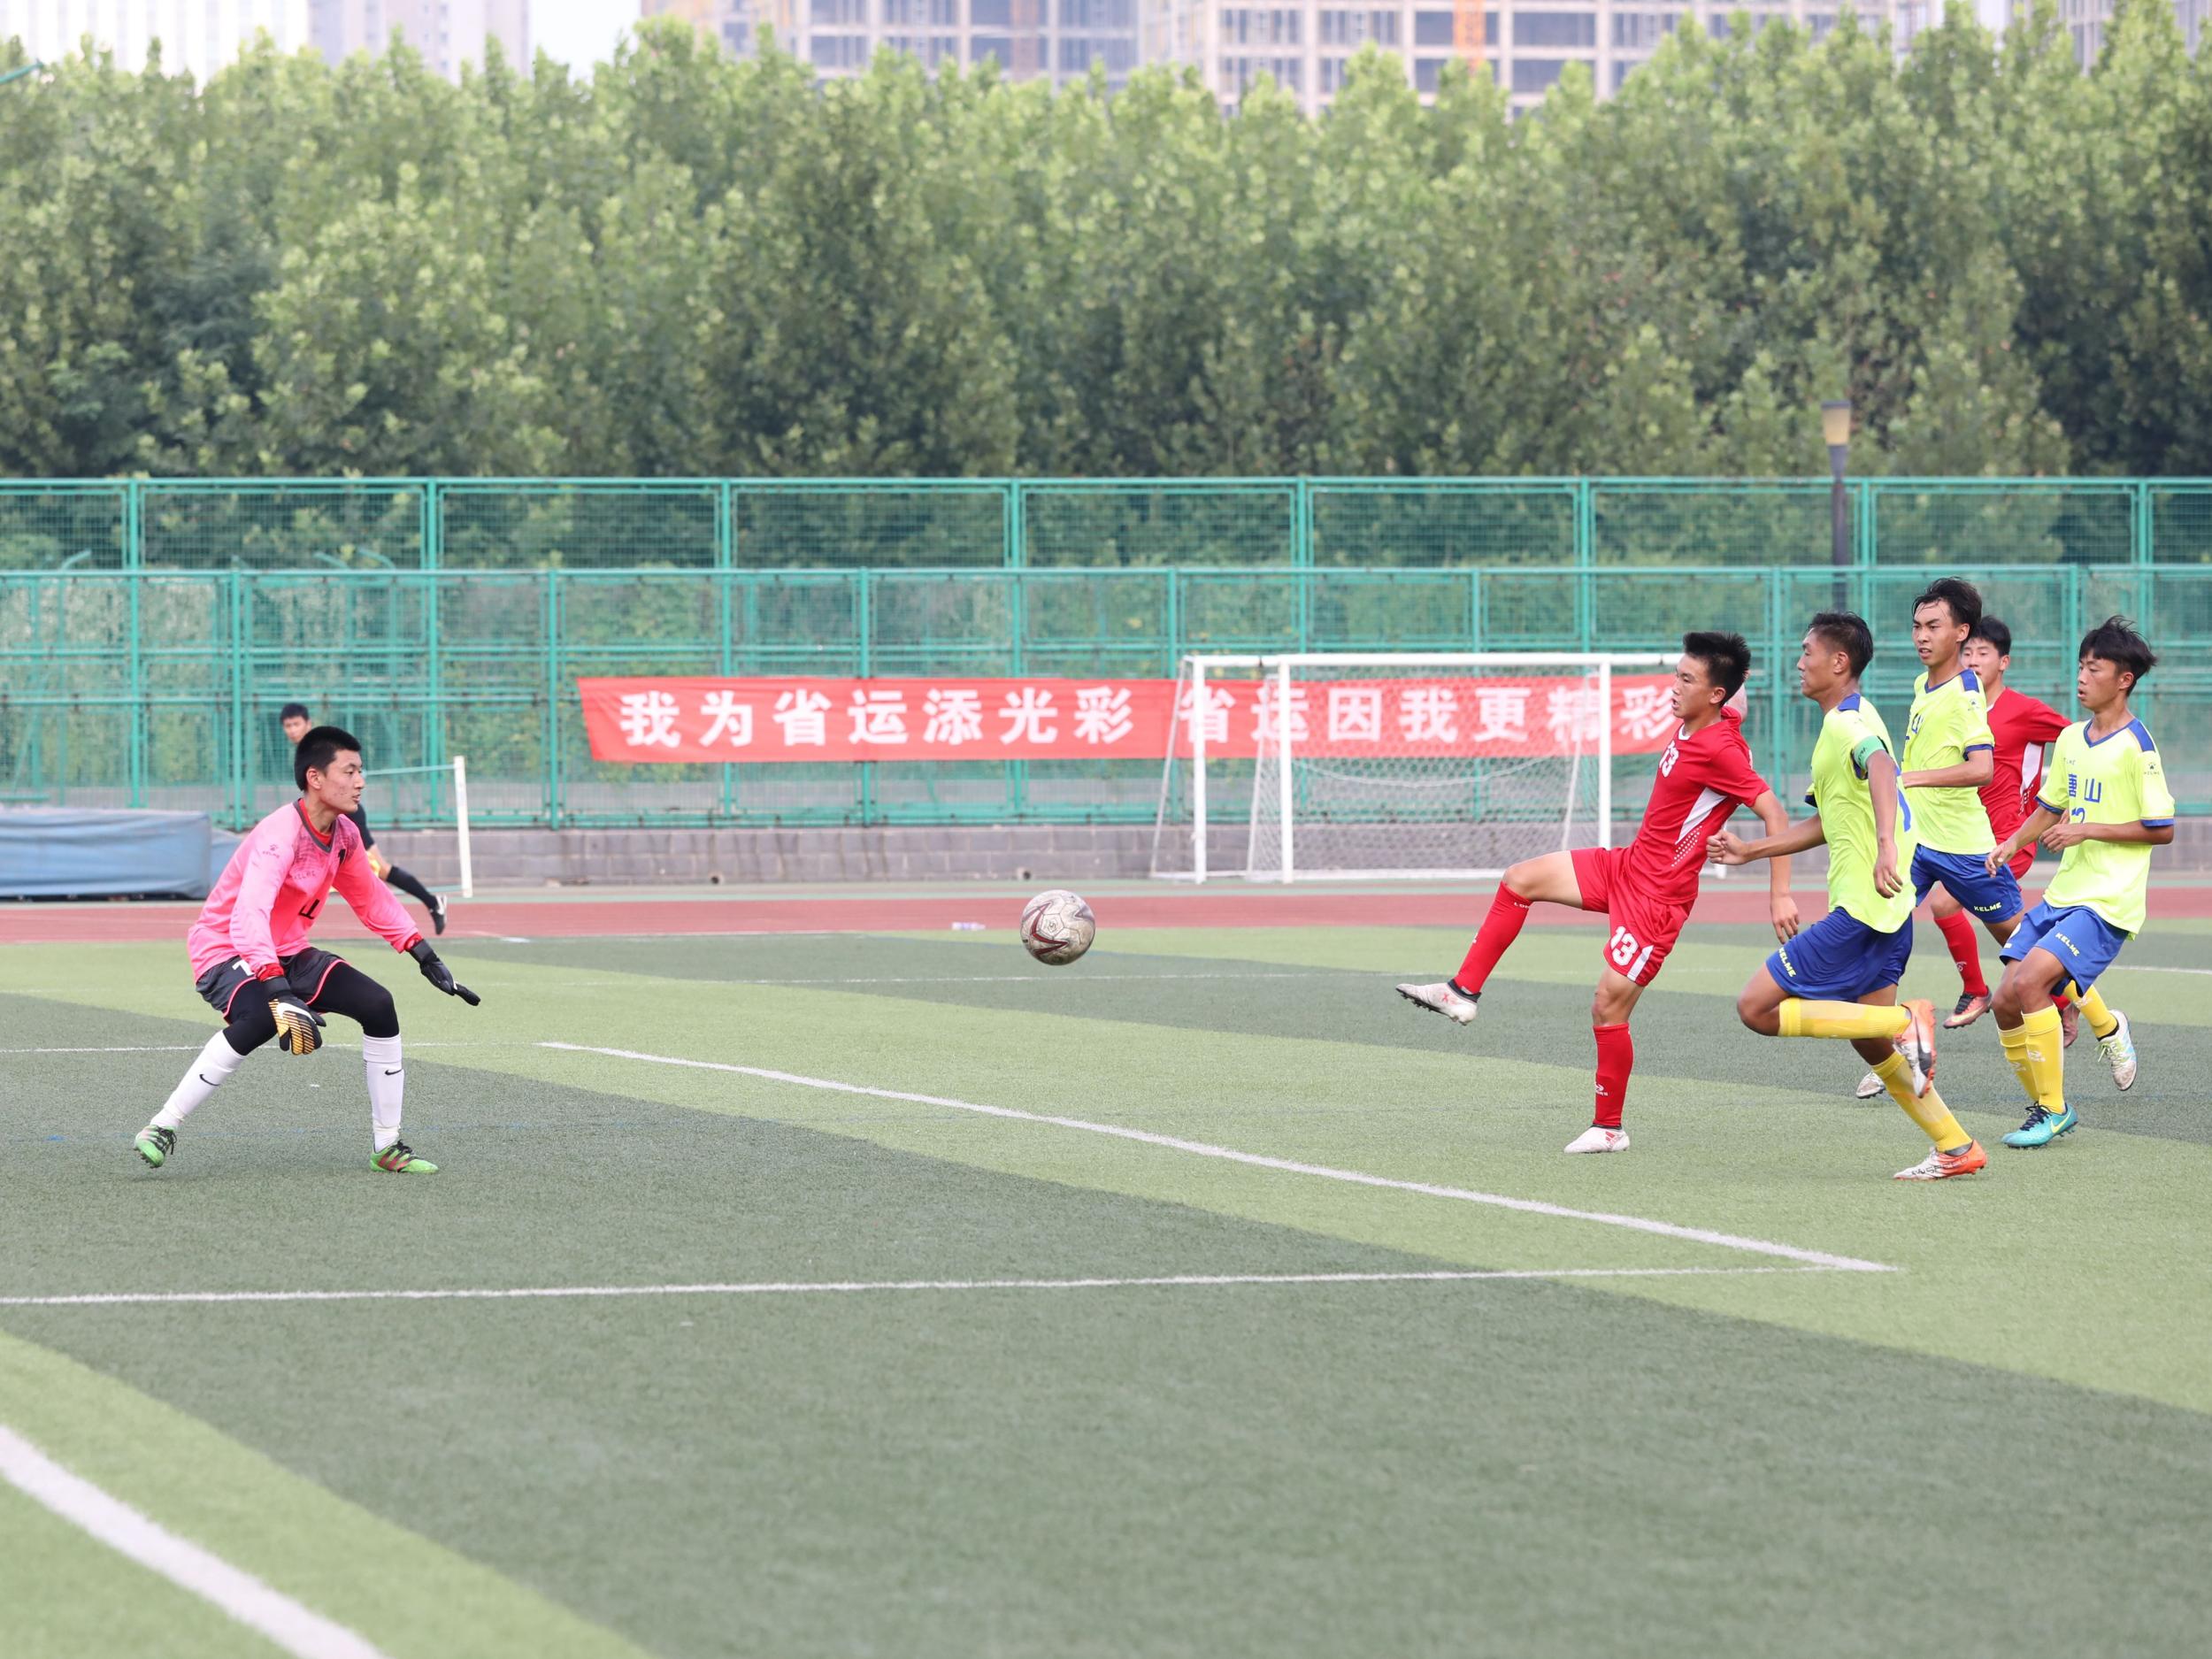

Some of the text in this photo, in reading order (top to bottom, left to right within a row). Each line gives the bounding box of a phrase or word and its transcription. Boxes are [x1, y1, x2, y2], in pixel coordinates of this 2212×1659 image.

[620, 685, 1677, 747] 我为省运添光彩 省运因我更精彩
[1659, 740, 1679, 778] 13
[1974, 902, 2002, 913] KELME
[1610, 926, 1640, 966] 13
[2055, 932, 2080, 956] KELME
